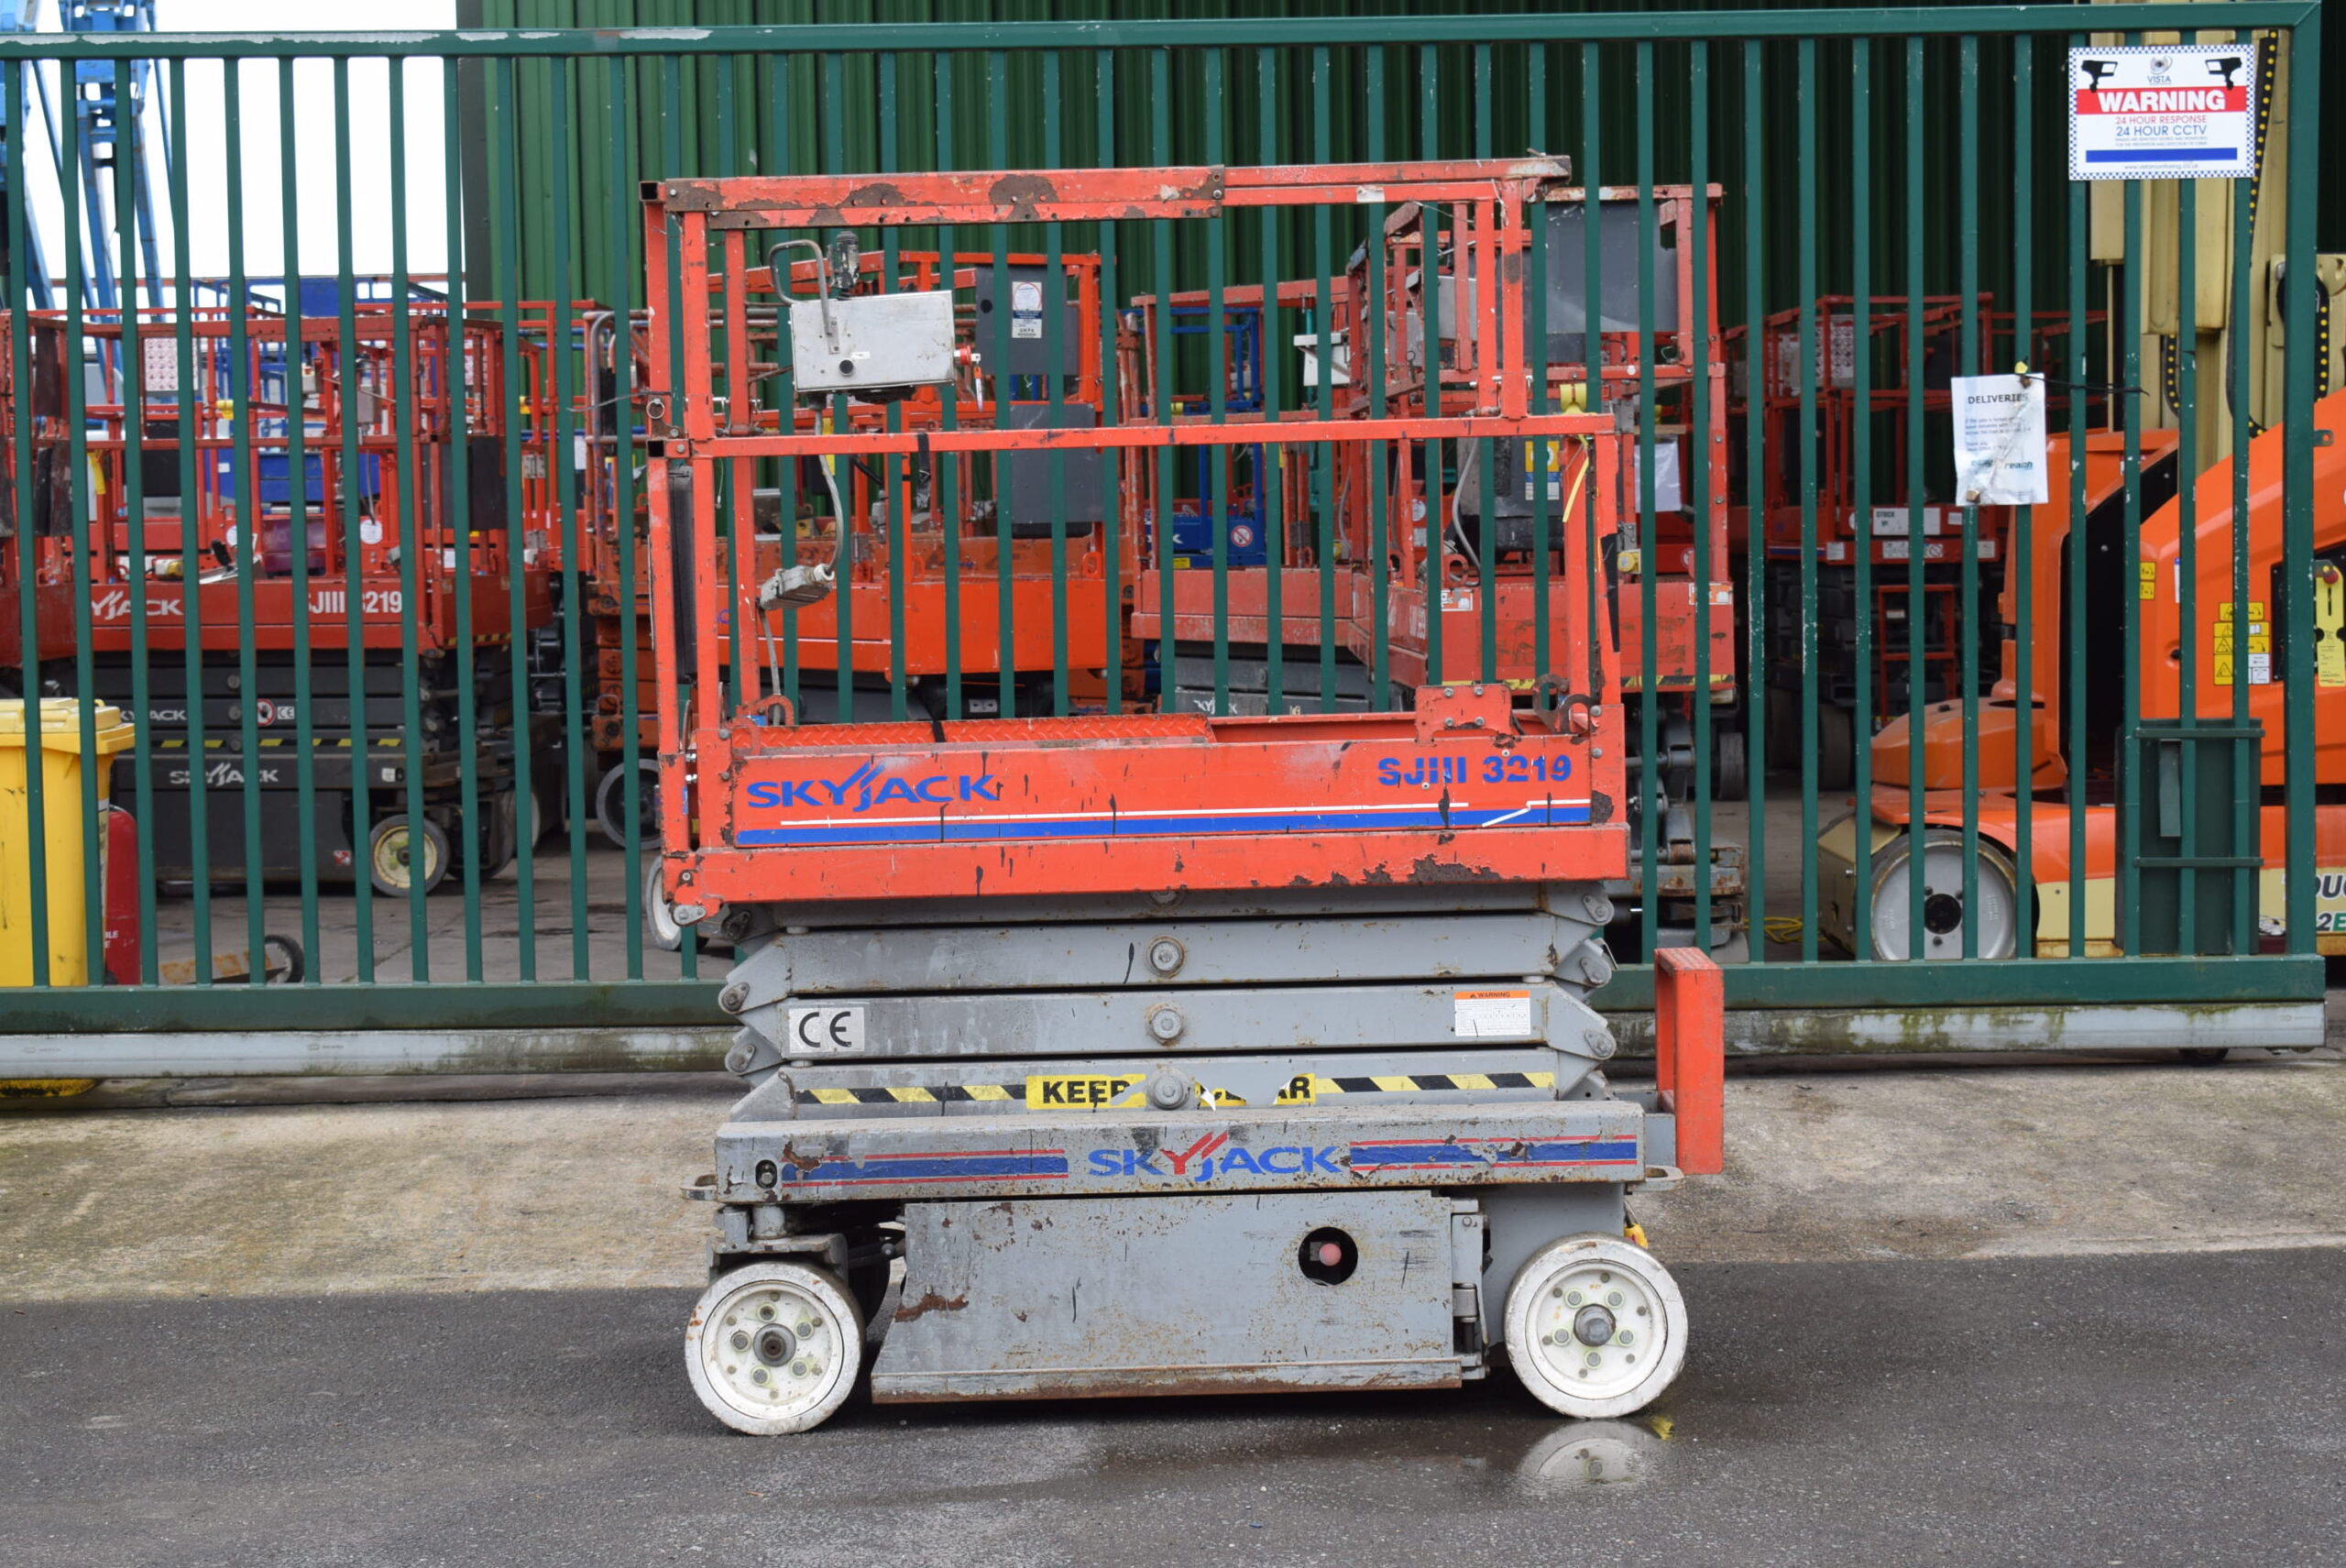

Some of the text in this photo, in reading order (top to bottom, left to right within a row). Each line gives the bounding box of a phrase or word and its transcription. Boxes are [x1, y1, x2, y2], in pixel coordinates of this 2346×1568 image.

[2147, 75, 2171, 83] VISTA
[2098, 90, 2226, 113] WARNING
[2115, 115, 2207, 125] 24 HOUR RESPONSE
[2116, 125, 2207, 137] 24 HOUR CCTV
[1968, 393, 2028, 404] DELIVERIES
[92, 590, 183, 620] YJACK
[363, 591, 402, 613] 219
[170, 762, 279, 787] SYJAK
[1377, 754, 1572, 786] SJIII 3219
[747, 762, 1000, 812] SKYJACK
[799, 1011, 852, 1047] CE
[1088, 1130, 1344, 1182] SKYJACK
